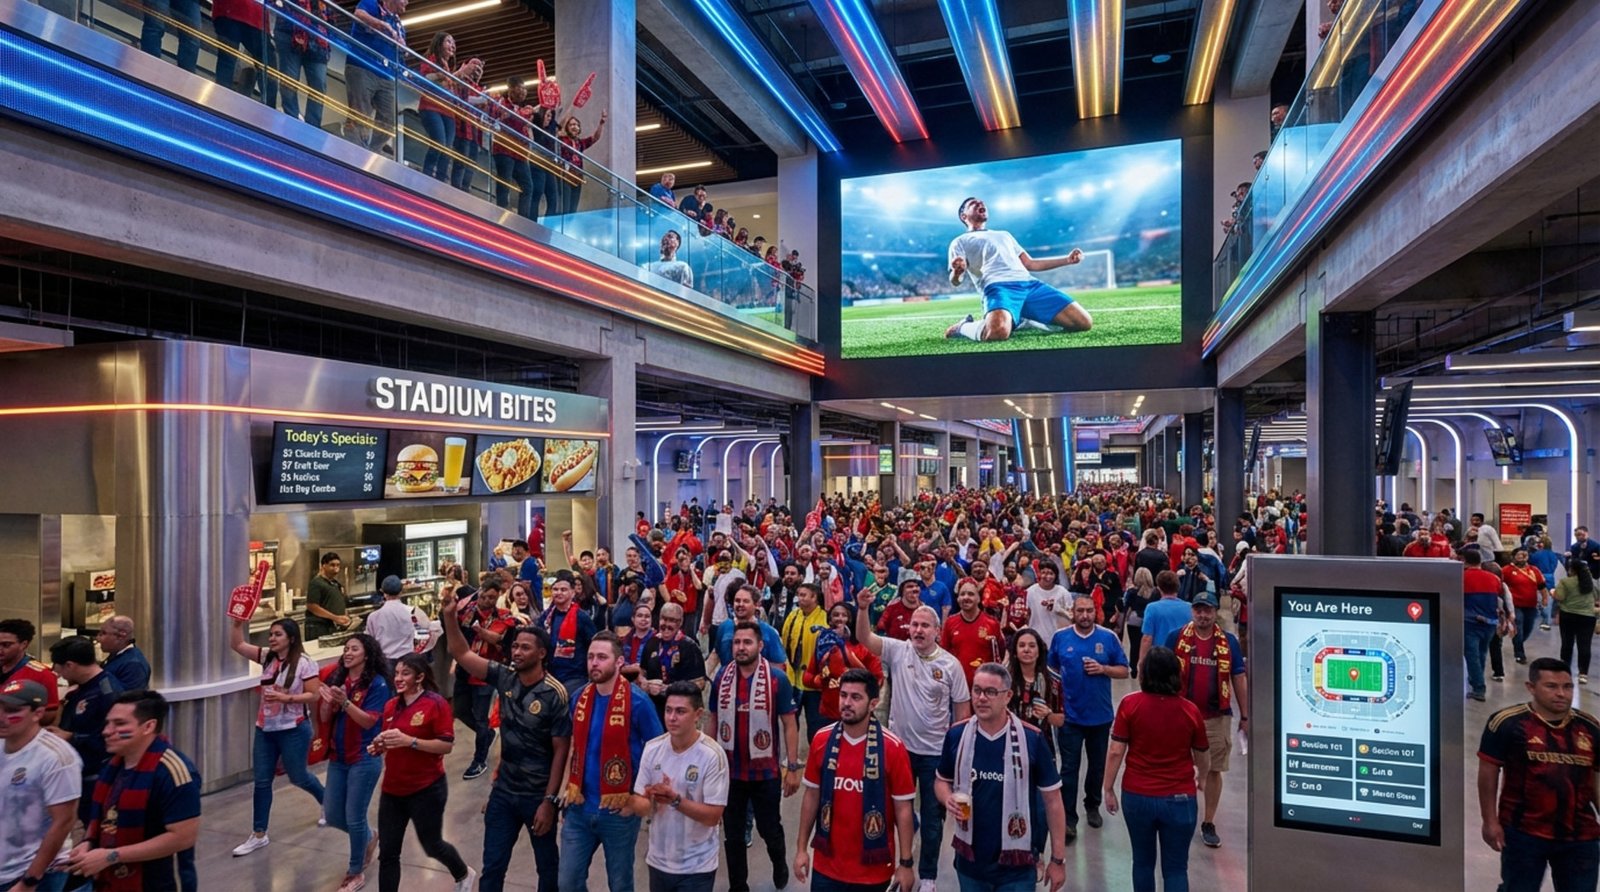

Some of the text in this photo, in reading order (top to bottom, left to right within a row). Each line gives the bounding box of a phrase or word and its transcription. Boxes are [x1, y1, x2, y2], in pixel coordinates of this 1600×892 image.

[376, 376, 557, 423] STADIUM BITES
[285, 429, 329, 446] Today's
[1288, 600, 1373, 615] You Are Here
